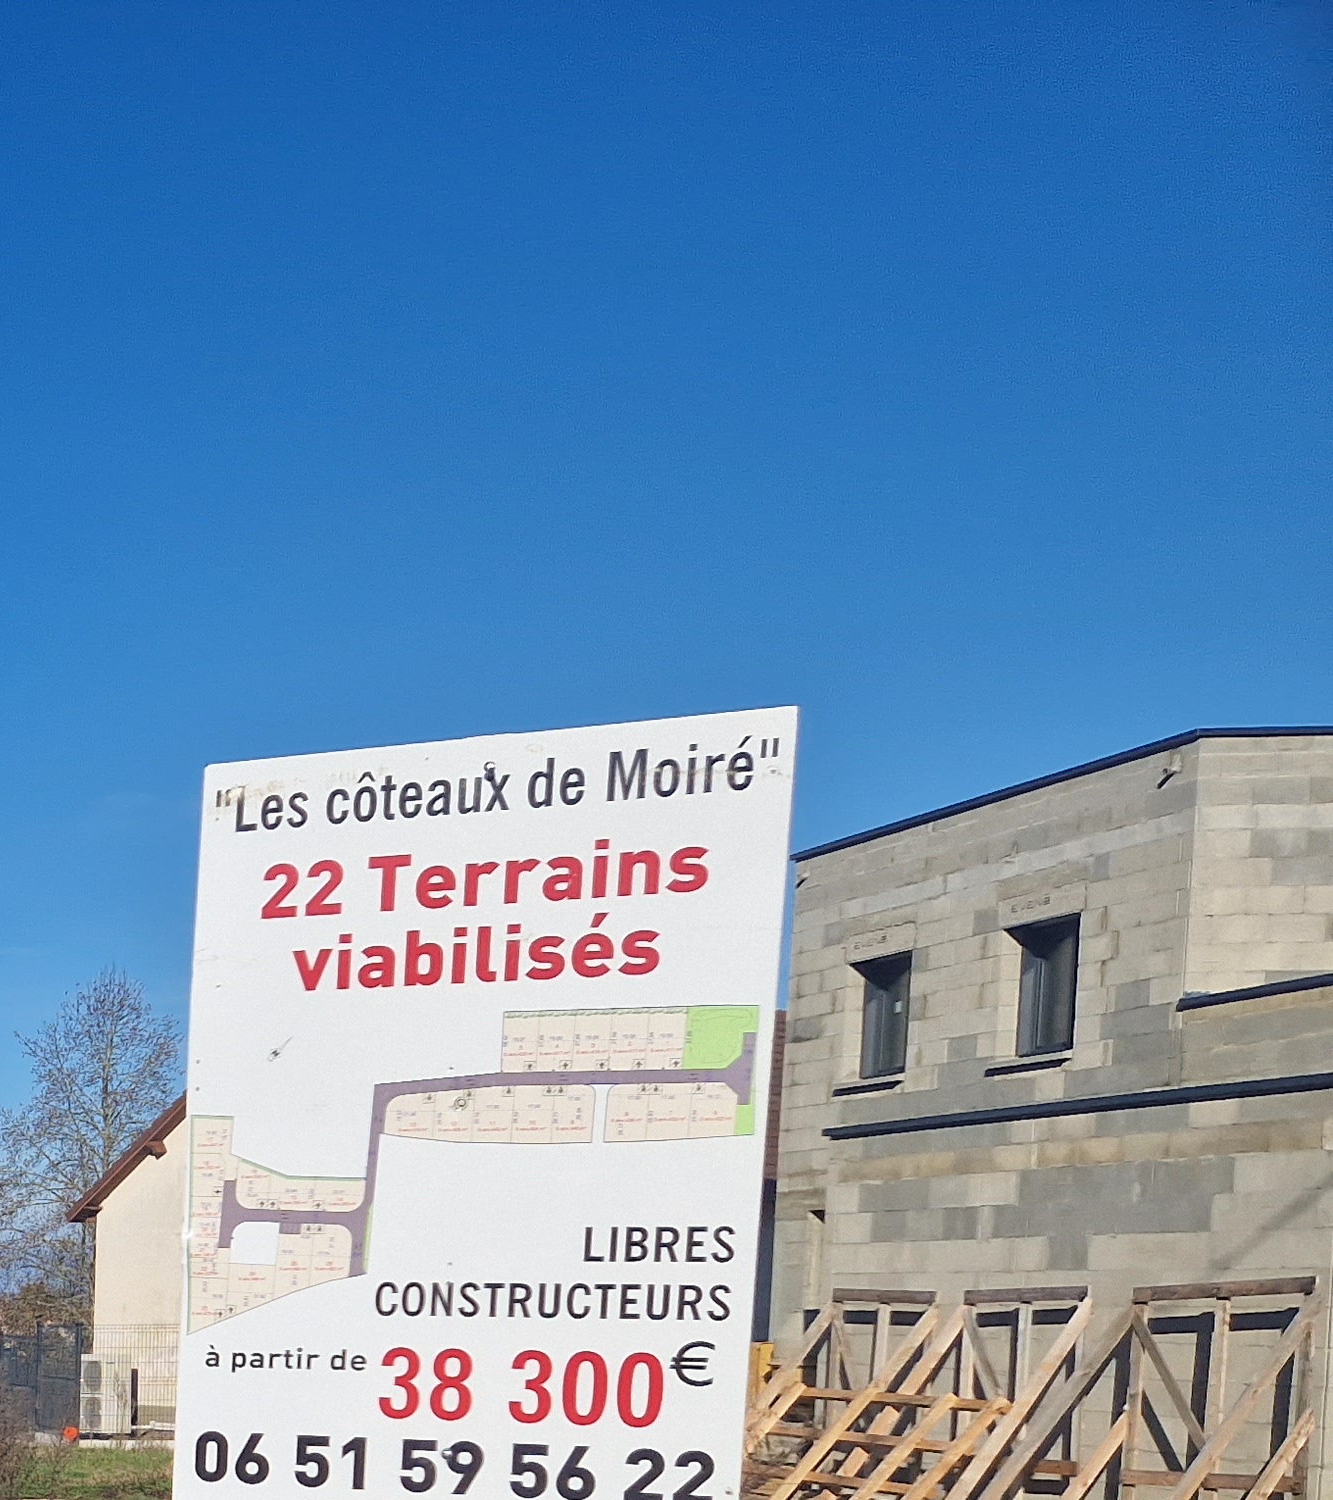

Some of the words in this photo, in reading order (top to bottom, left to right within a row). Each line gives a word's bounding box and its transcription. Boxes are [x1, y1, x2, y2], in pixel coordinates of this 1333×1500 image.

[217, 789, 308, 832] "Les
[327, 770, 510, 824] côteaux
[528, 758, 584, 808] de
[607, 736, 778, 801] Moiré"
[262, 861, 342, 919] 22
[370, 840, 707, 915] Terrains
[293, 912, 660, 991] viabilisés
[584, 1226, 735, 1263] LIBRES
[376, 1282, 730, 1321] CONSTRUCTEURS
[206, 1345, 219, 1367] à
[232, 1348, 319, 1372] partir
[331, 1349, 366, 1371] de
[379, 1348, 472, 1421] 38
[509, 1350, 663, 1427] 300
[670, 1341, 715, 1386] €
[195, 1431, 269, 1484] 06
[295, 1435, 366, 1489] 51
[401, 1439, 483, 1494] 59
[510, 1444, 595, 1500] 56
